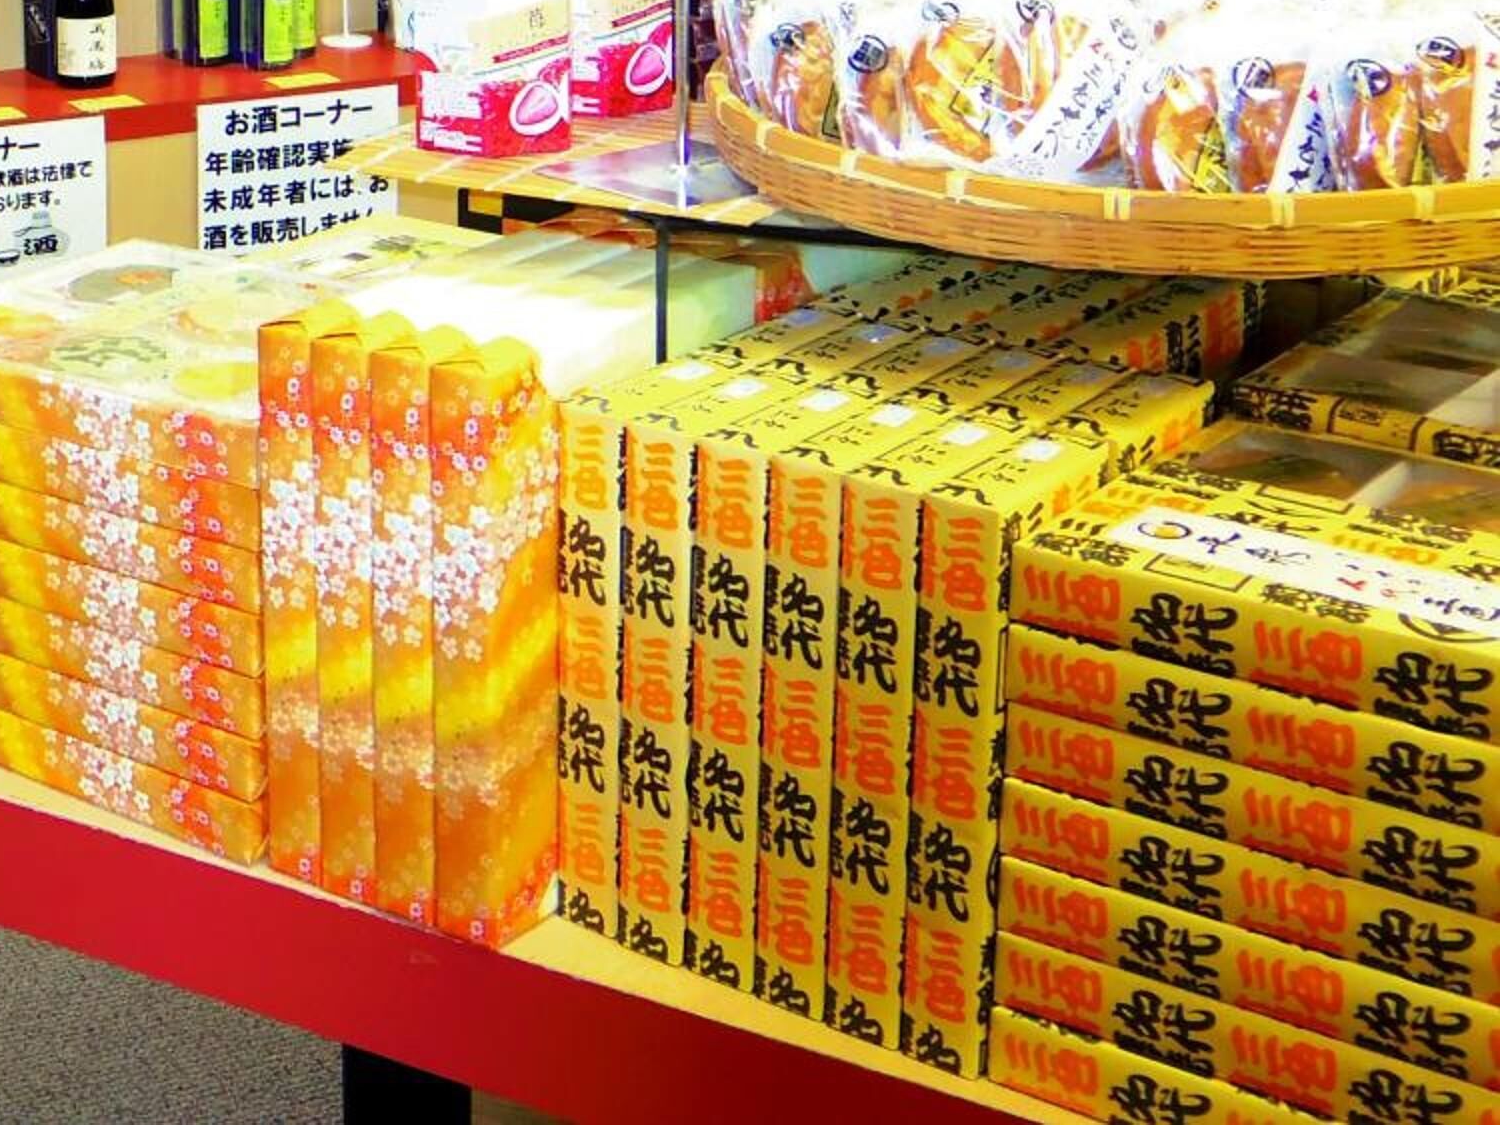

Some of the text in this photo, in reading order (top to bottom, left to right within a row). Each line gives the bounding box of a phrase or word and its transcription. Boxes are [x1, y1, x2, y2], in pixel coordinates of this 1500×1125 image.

[225, 99, 373, 136] お酒コーナー
[23, 234, 58, 256] 酒
